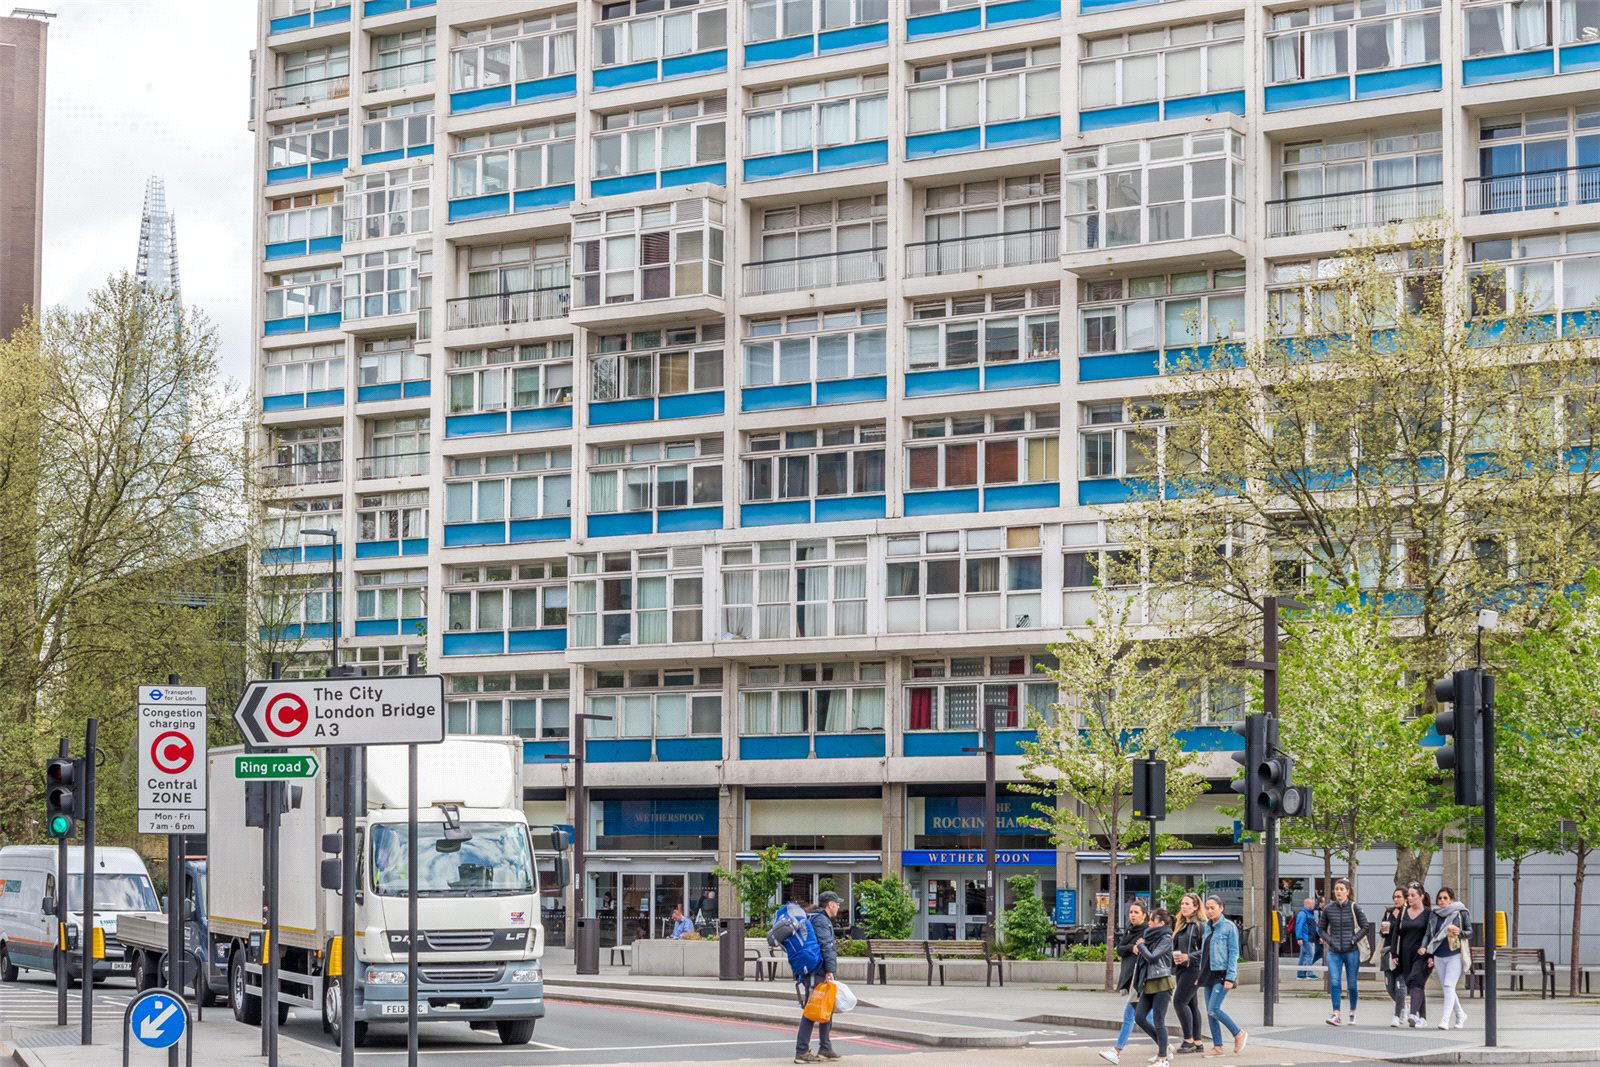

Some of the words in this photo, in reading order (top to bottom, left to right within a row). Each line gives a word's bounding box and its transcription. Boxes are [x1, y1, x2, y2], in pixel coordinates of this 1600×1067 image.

[313, 687, 343, 700] The
[349, 686, 383, 702] City
[142, 707, 203, 718] Congestion
[314, 705, 375, 719] London
[382, 703, 436, 719] Bridge
[149, 720, 196, 729] charging
[240, 761, 268, 775] Ring
[272, 761, 301, 773] road
[147, 778, 198, 790] Central
[152, 792, 192, 803] ZONE
[635, 813, 705, 822] WETHERSPOON
[928, 853, 1031, 863] WETHERPOON
[506, 932, 526, 940] LF
[386, 1005, 406, 1013] FE13
